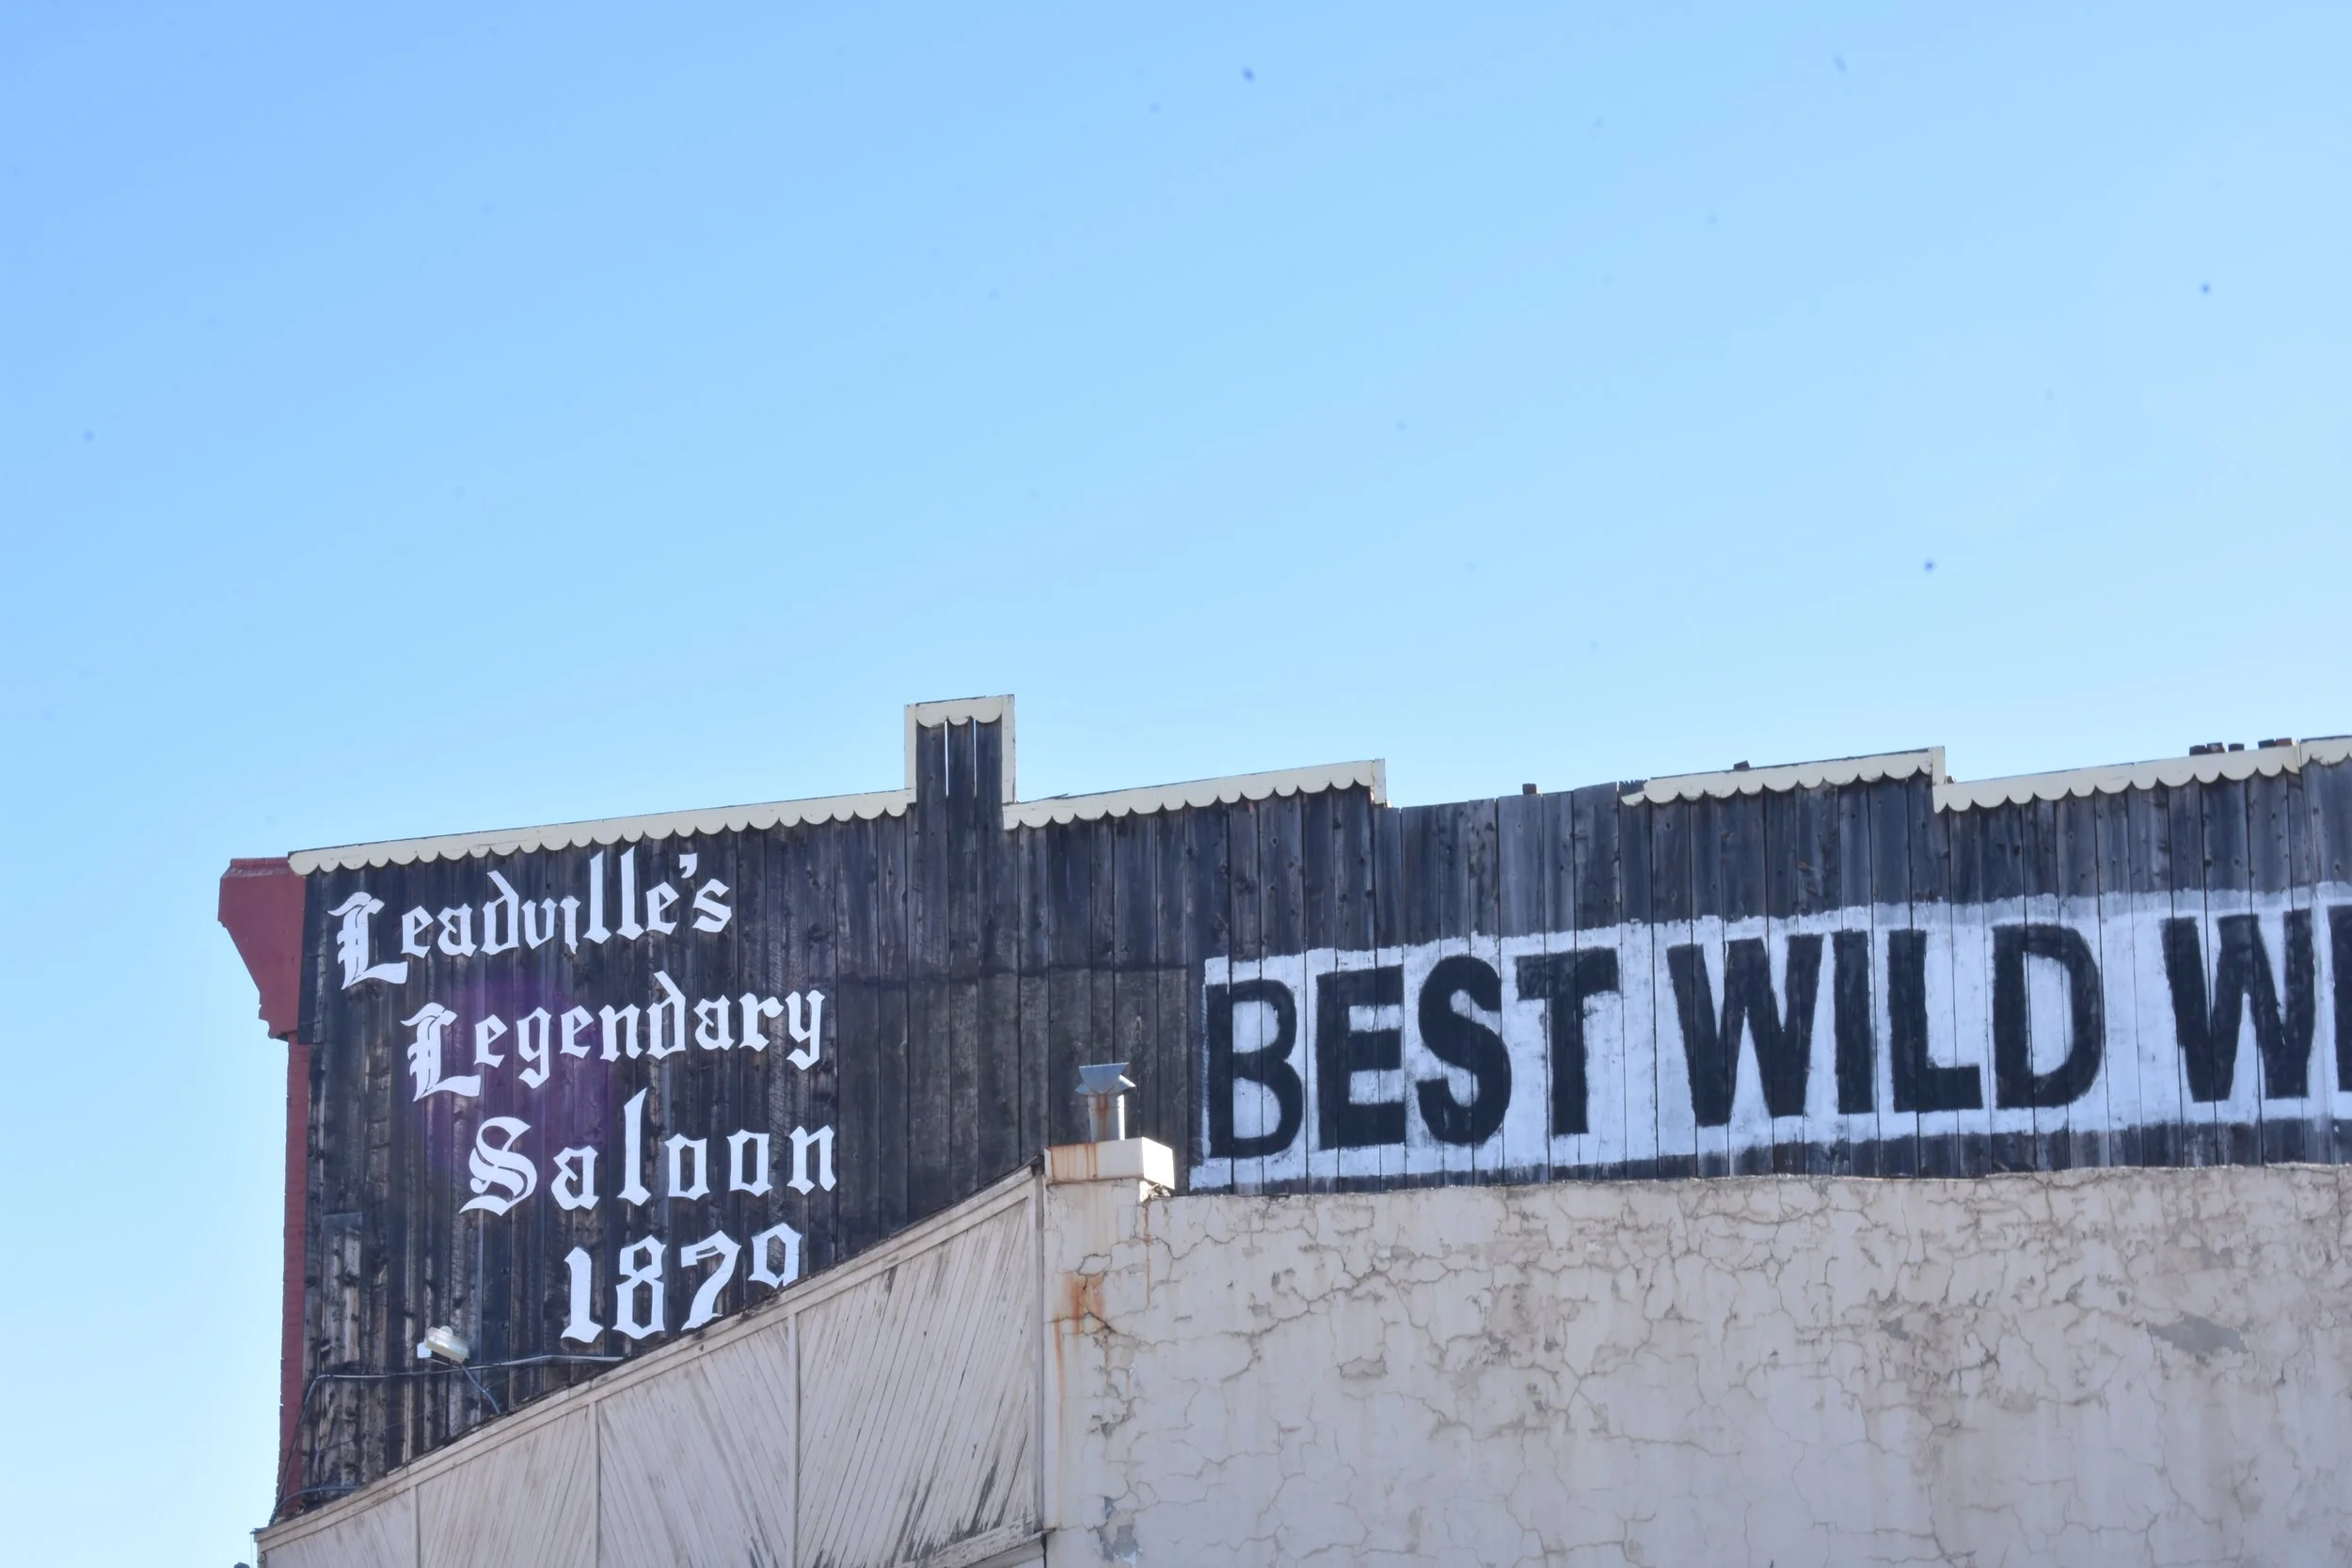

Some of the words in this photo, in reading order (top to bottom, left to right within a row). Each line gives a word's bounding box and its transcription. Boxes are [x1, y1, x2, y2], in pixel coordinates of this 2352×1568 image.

[327, 846, 732, 990] Leadville's
[400, 972, 825, 1102] Legendary
[1205, 948, 1618, 1159] BEST
[1666, 923, 2105, 1127] WILD
[459, 1087, 836, 1215] Saloon
[560, 1223, 803, 1343] 1870
